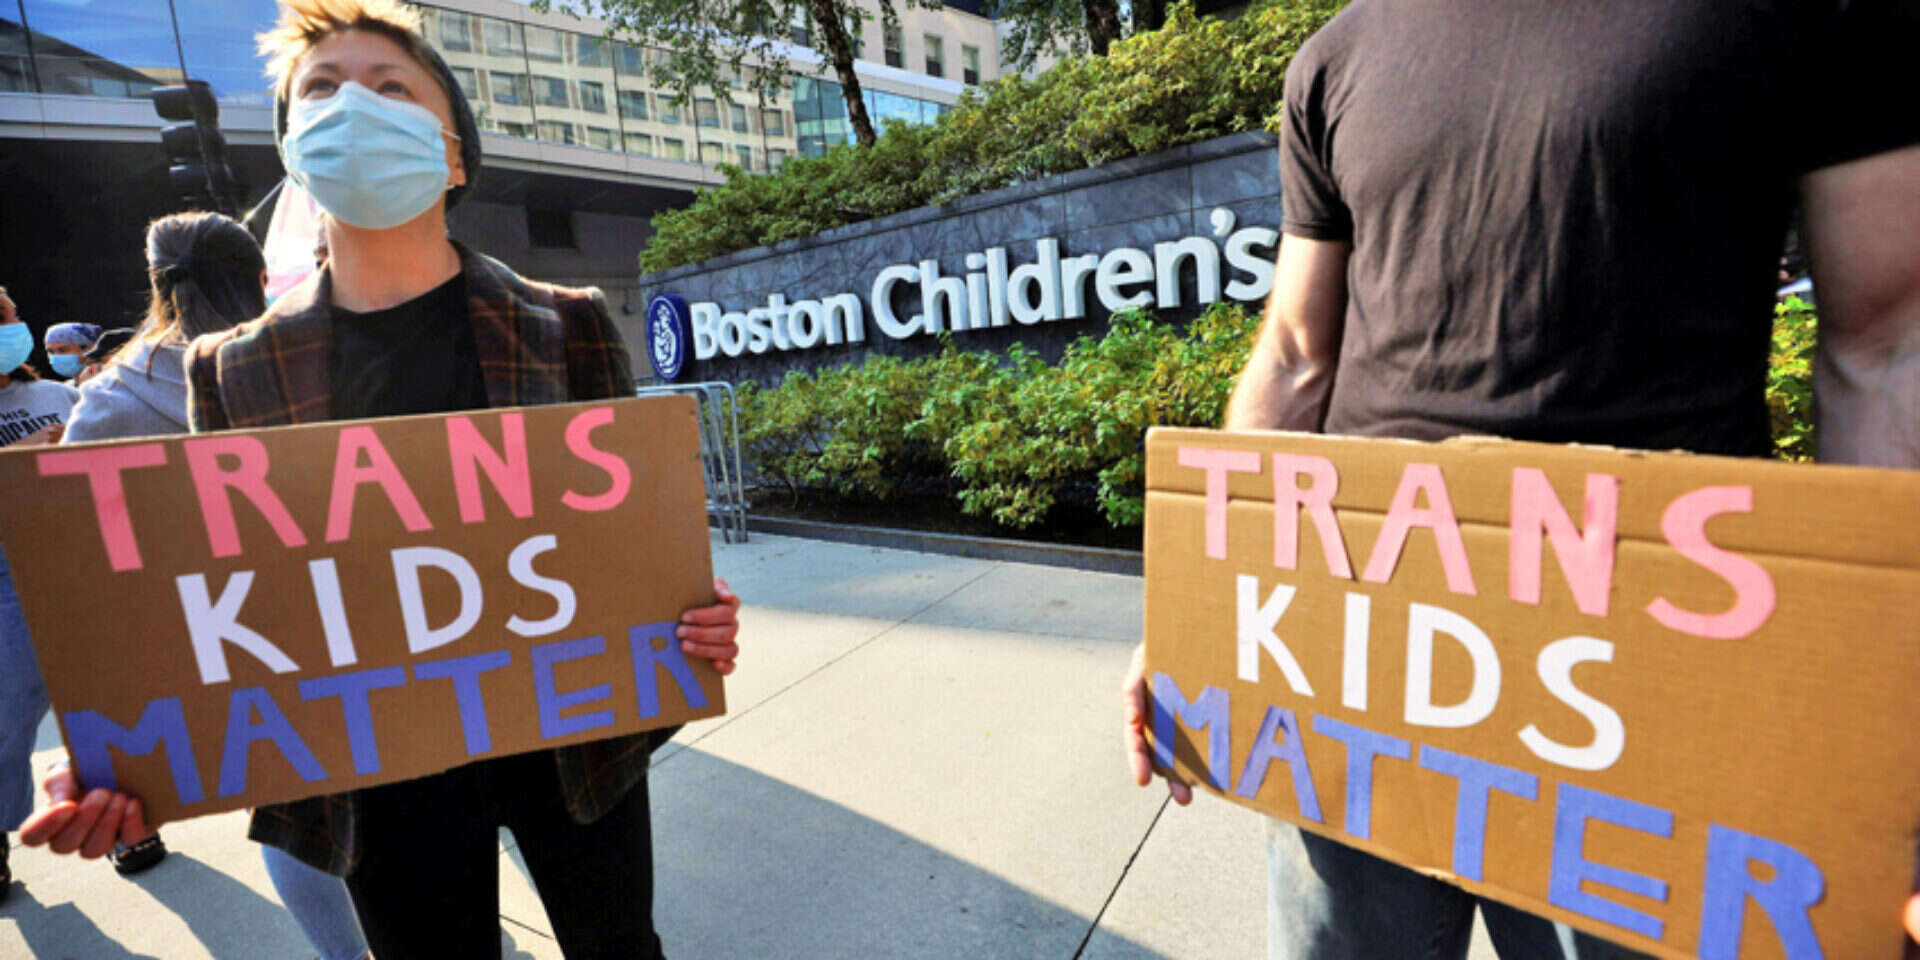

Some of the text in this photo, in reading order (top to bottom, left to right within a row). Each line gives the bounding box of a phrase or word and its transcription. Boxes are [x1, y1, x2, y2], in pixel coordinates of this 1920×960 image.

[690, 207, 1279, 361] Boston Children's
[37, 407, 632, 572] TRANS
[1178, 446, 1776, 640] TRANS
[176, 534, 577, 685] KIDS
[1236, 574, 1625, 771] KIDS
[62, 621, 709, 806] MATTER
[1150, 671, 1826, 960] MATTER
